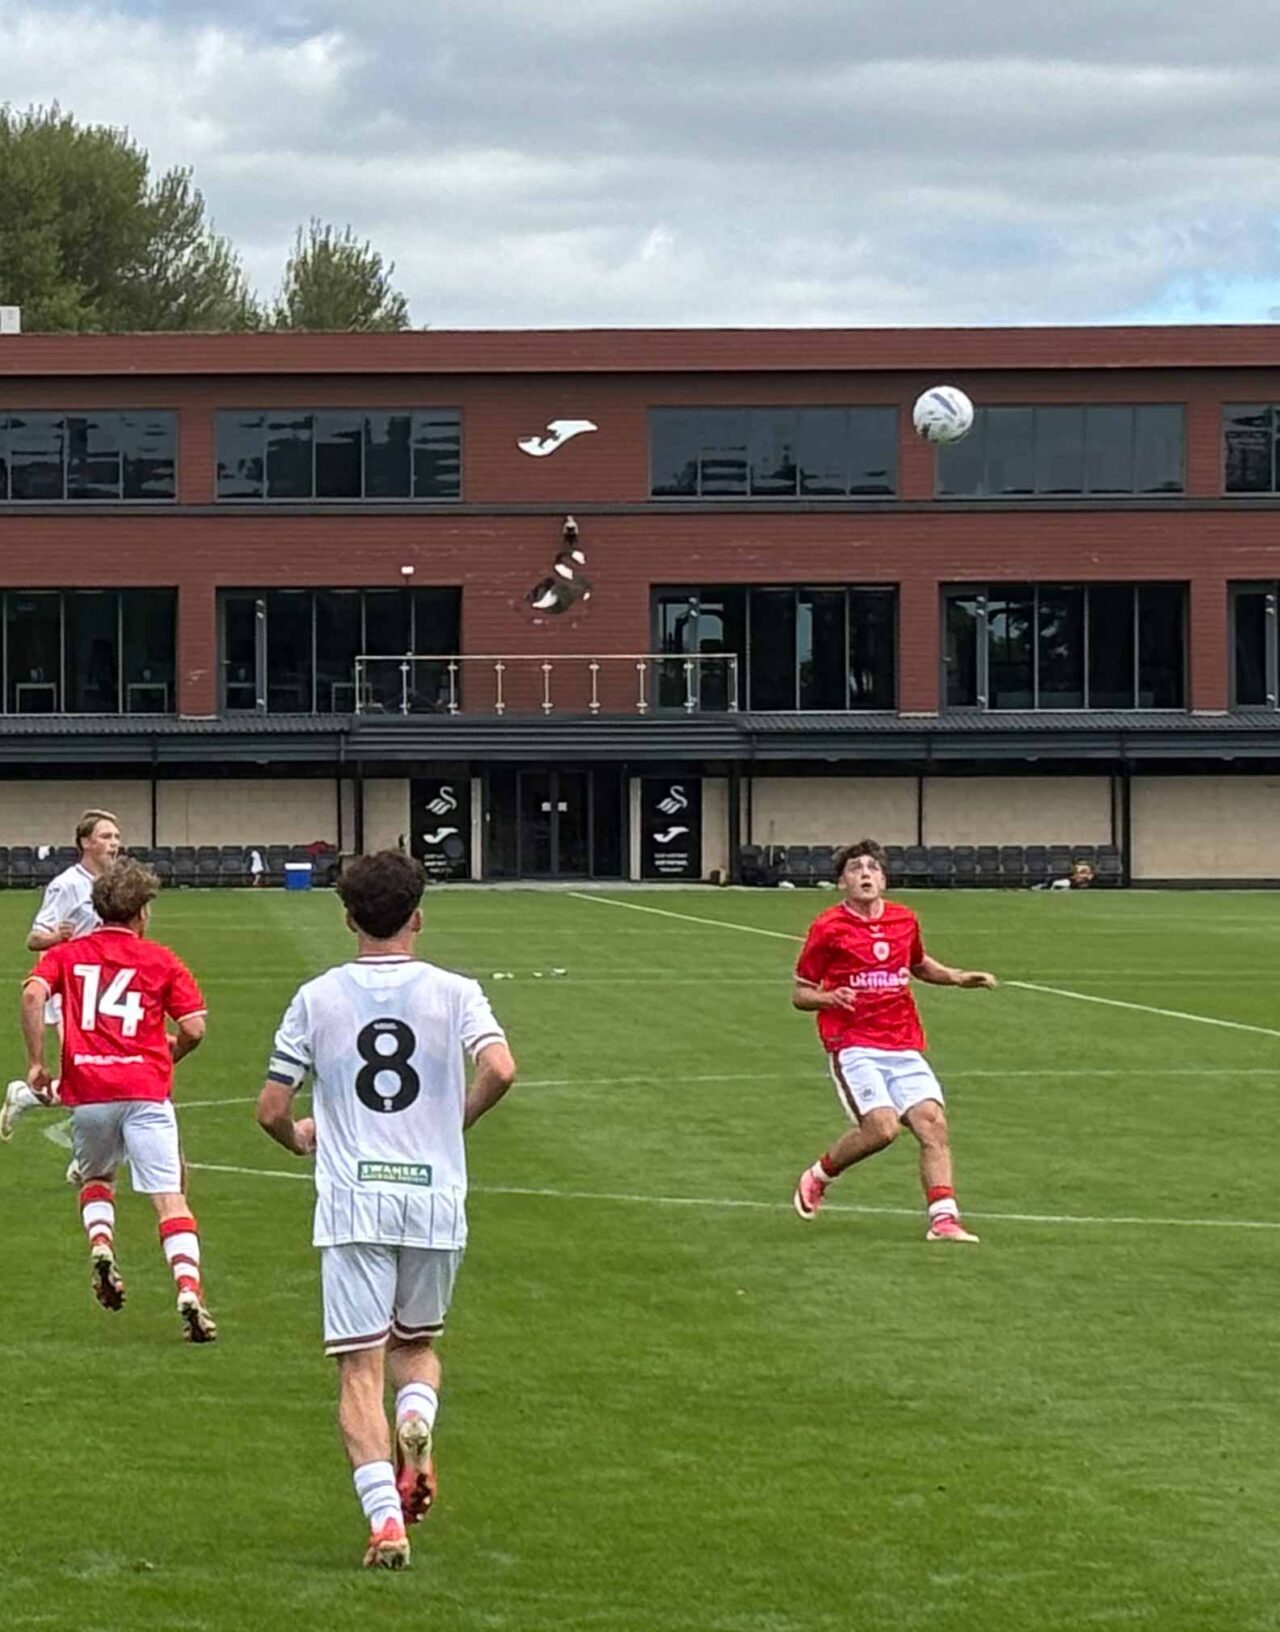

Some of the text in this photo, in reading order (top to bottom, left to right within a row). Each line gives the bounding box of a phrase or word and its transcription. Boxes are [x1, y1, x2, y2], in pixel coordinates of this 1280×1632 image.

[73, 963, 145, 1037] 14
[355, 1017, 420, 1113] 8
[361, 1164, 429, 1178] SWANSEA
